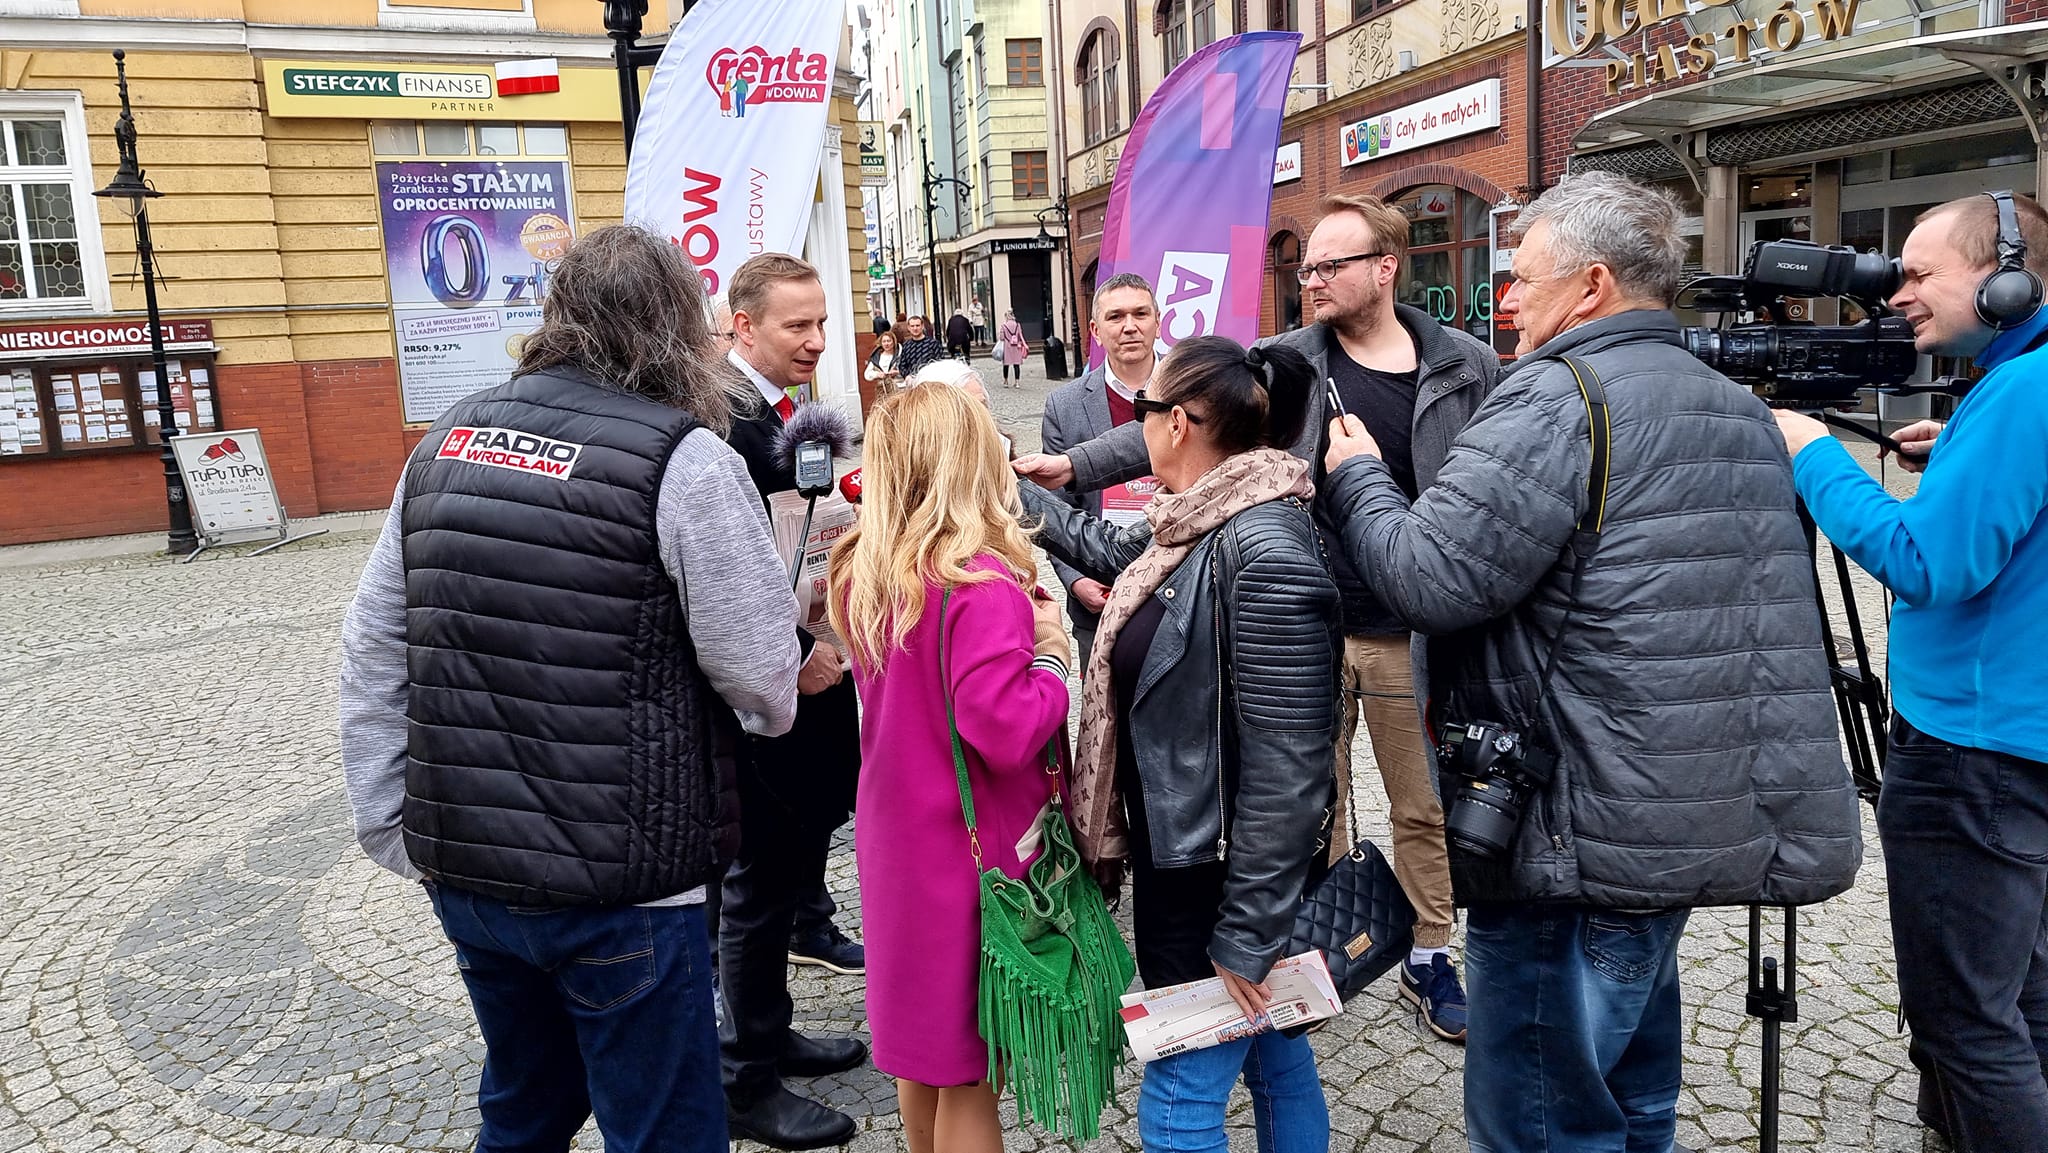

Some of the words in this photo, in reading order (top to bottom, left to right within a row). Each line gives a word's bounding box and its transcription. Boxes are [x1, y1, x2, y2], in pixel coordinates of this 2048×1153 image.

[1605, 0, 1861, 96] PIASTÓW
[717, 47, 828, 85] renta
[293, 74, 393, 92] STEFCZYK
[404, 77, 484, 94] FINANSE
[765, 87, 818, 100] WDOWIA
[431, 101, 495, 112] PARTNER
[1396, 118, 1417, 139] Cały
[1421, 112, 1438, 131] dla
[391, 173, 448, 185] Pożyczka
[392, 184, 435, 194] Zaratka
[436, 186, 449, 194] ze
[451, 173, 554, 194] STAŁYM
[392, 197, 556, 212] OPROCENTOWANIEM
[746, 167, 769, 256] ustawy
[1003, 242, 1027, 252] JUNIOR
[420, 214, 491, 309] 0
[404, 344, 432, 353] RRSO:
[433, 343, 461, 352] 9,27%
[470, 431, 577, 462] RADIO
[466, 449, 569, 475] WROCŁAW
[1157, 1043, 1187, 1058] DEKADA
